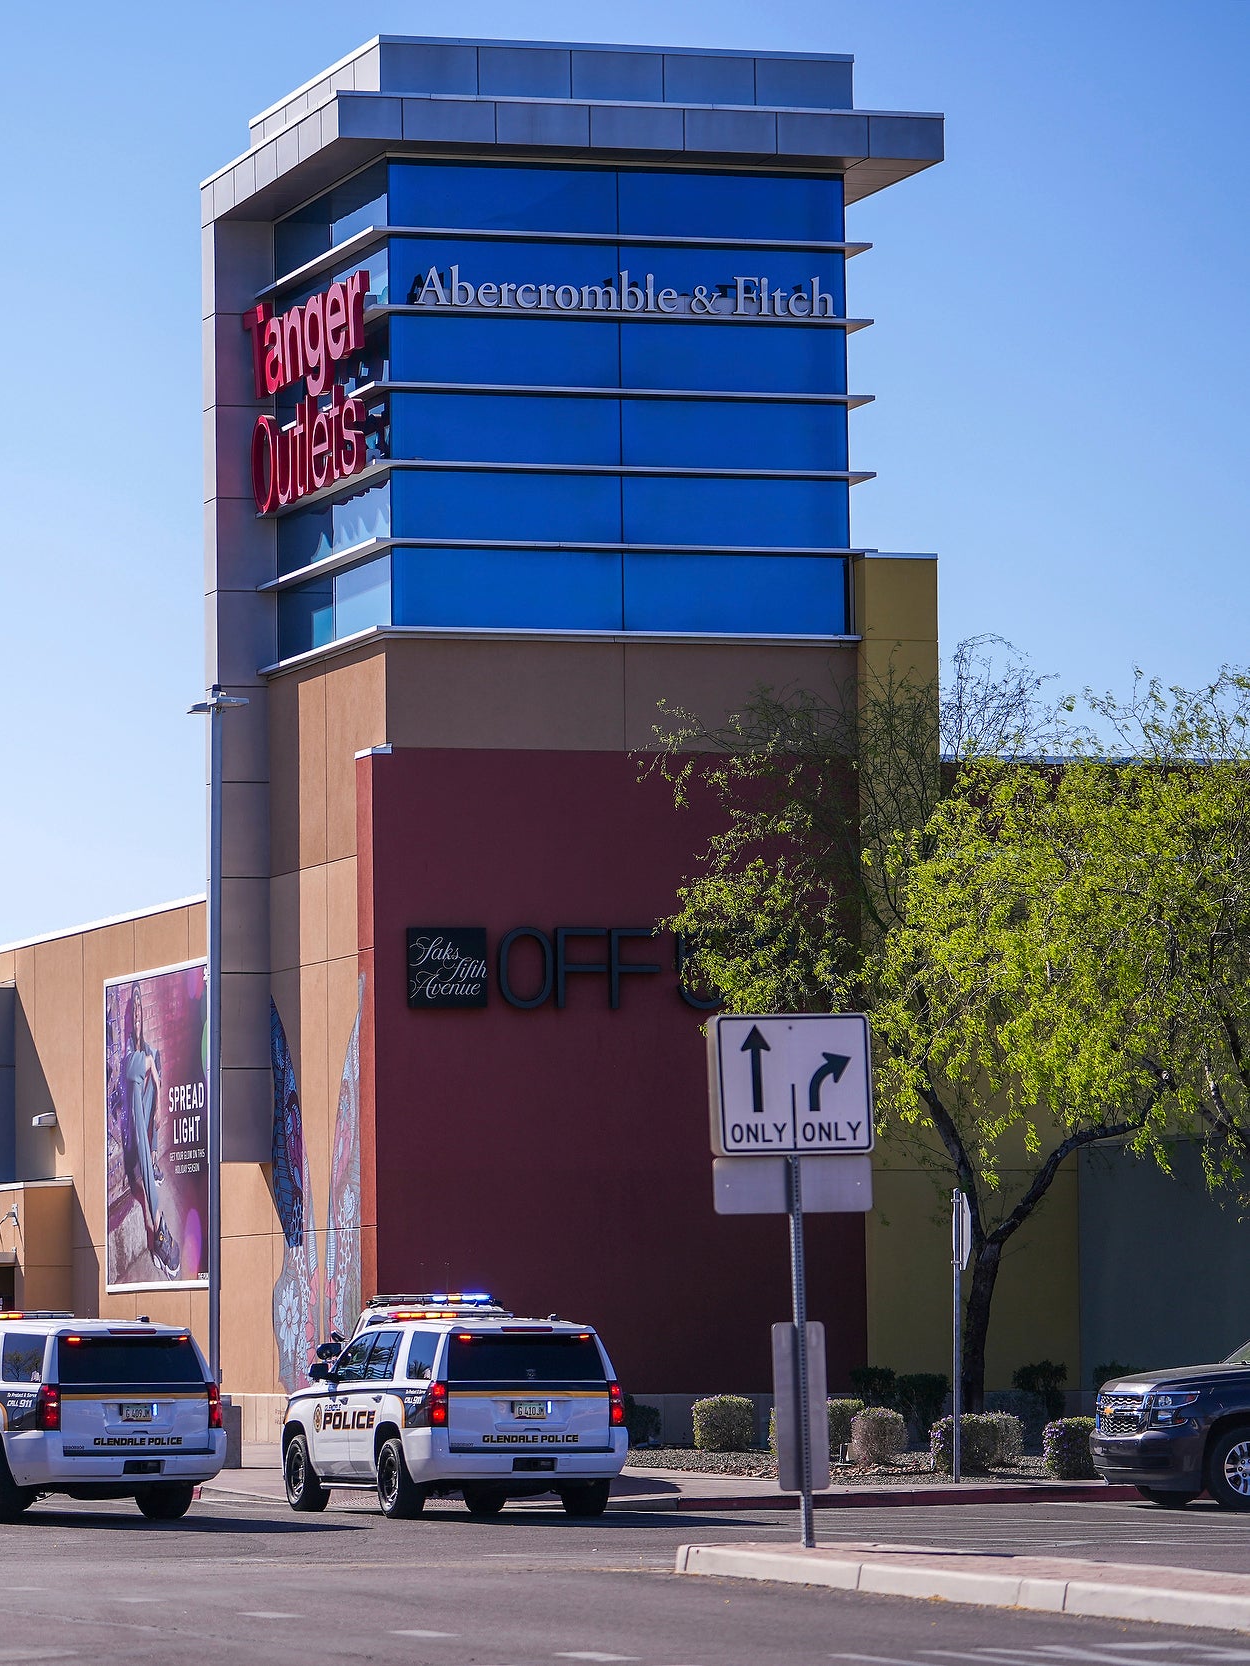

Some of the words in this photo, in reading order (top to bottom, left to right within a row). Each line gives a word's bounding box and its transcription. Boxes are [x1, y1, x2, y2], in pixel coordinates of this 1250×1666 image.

[413, 265, 678, 313] Abercrombie
[691, 285, 721, 315] &
[732, 275, 837, 319] Fitch
[243, 270, 370, 400] Tanger
[252, 384, 367, 514] Outlets
[409, 936, 459, 969] Saks
[498, 926, 660, 1009] OFF
[409, 971, 481, 999] Avenue
[168, 1082, 205, 1113] SPREAD
[173, 1115, 201, 1145] LIGHT
[731, 1122, 787, 1143] ONLY
[802, 1120, 862, 1142] ONLY
[7, 1399, 19, 1407] CALL
[19, 1399, 33, 1408] 911
[322, 1410, 376, 1430] POLICE
[93, 1437, 147, 1446] GLENDALE
[148, 1437, 183, 1445] POLICE
[482, 1434, 539, 1443] GLENDALE
[541, 1434, 579, 1443] POLICE
